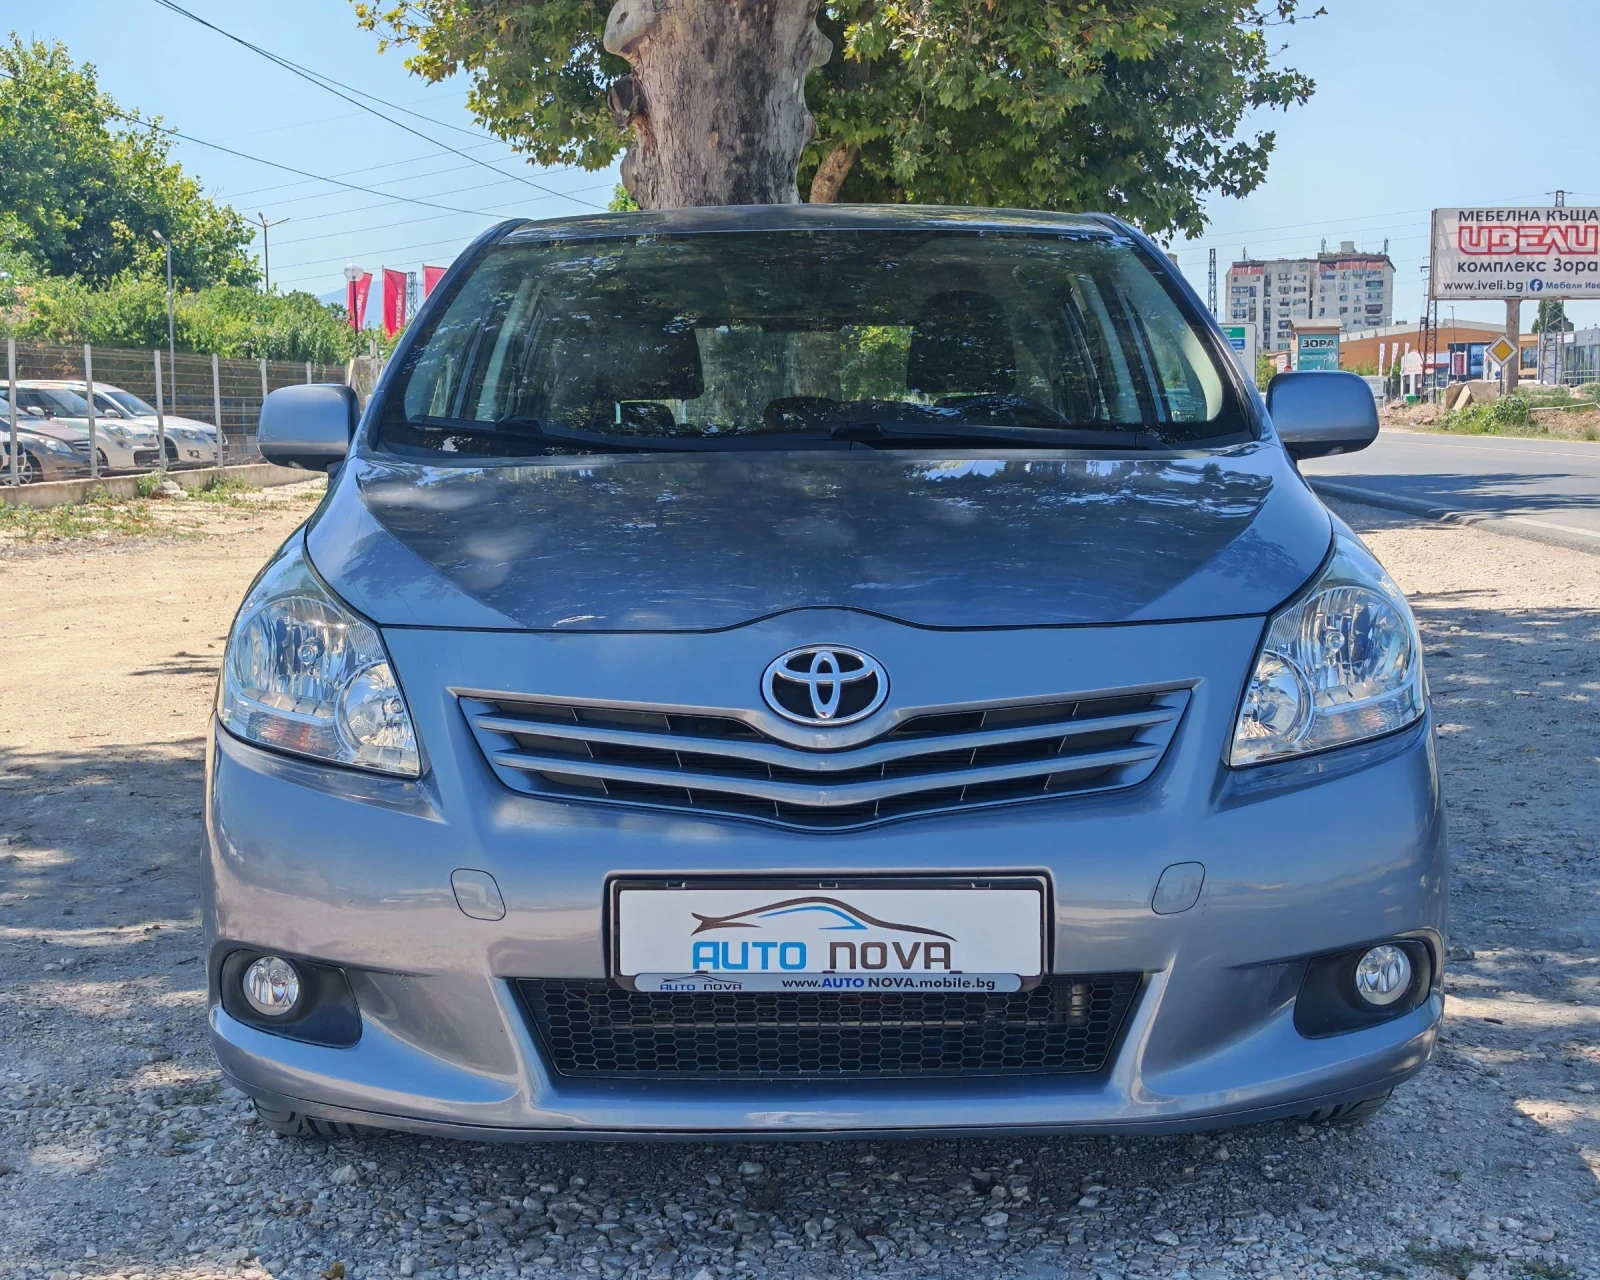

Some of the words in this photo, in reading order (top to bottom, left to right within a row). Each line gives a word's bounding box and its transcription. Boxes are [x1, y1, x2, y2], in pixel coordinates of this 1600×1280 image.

[1458, 210, 1541, 222] МЕБЕЛНА
[1546, 209, 1599, 223] КЪЩА
[1457, 261, 1547, 273] комплекс
[1552, 258, 1598, 275] Зора
[1443, 279, 1523, 292] www.iveli.bg
[1545, 281, 1582, 290] Мебели
[1301, 339, 1336, 349] ЗОРА
[692, 941, 807, 970] AUTO
[829, 941, 951, 970] NOVA
[660, 983, 696, 991] AUTO
[703, 983, 742, 991] NOVA
[782, 977, 865, 989] www.AUTO
[868, 977, 996, 991] NOVA.mobile.bg
